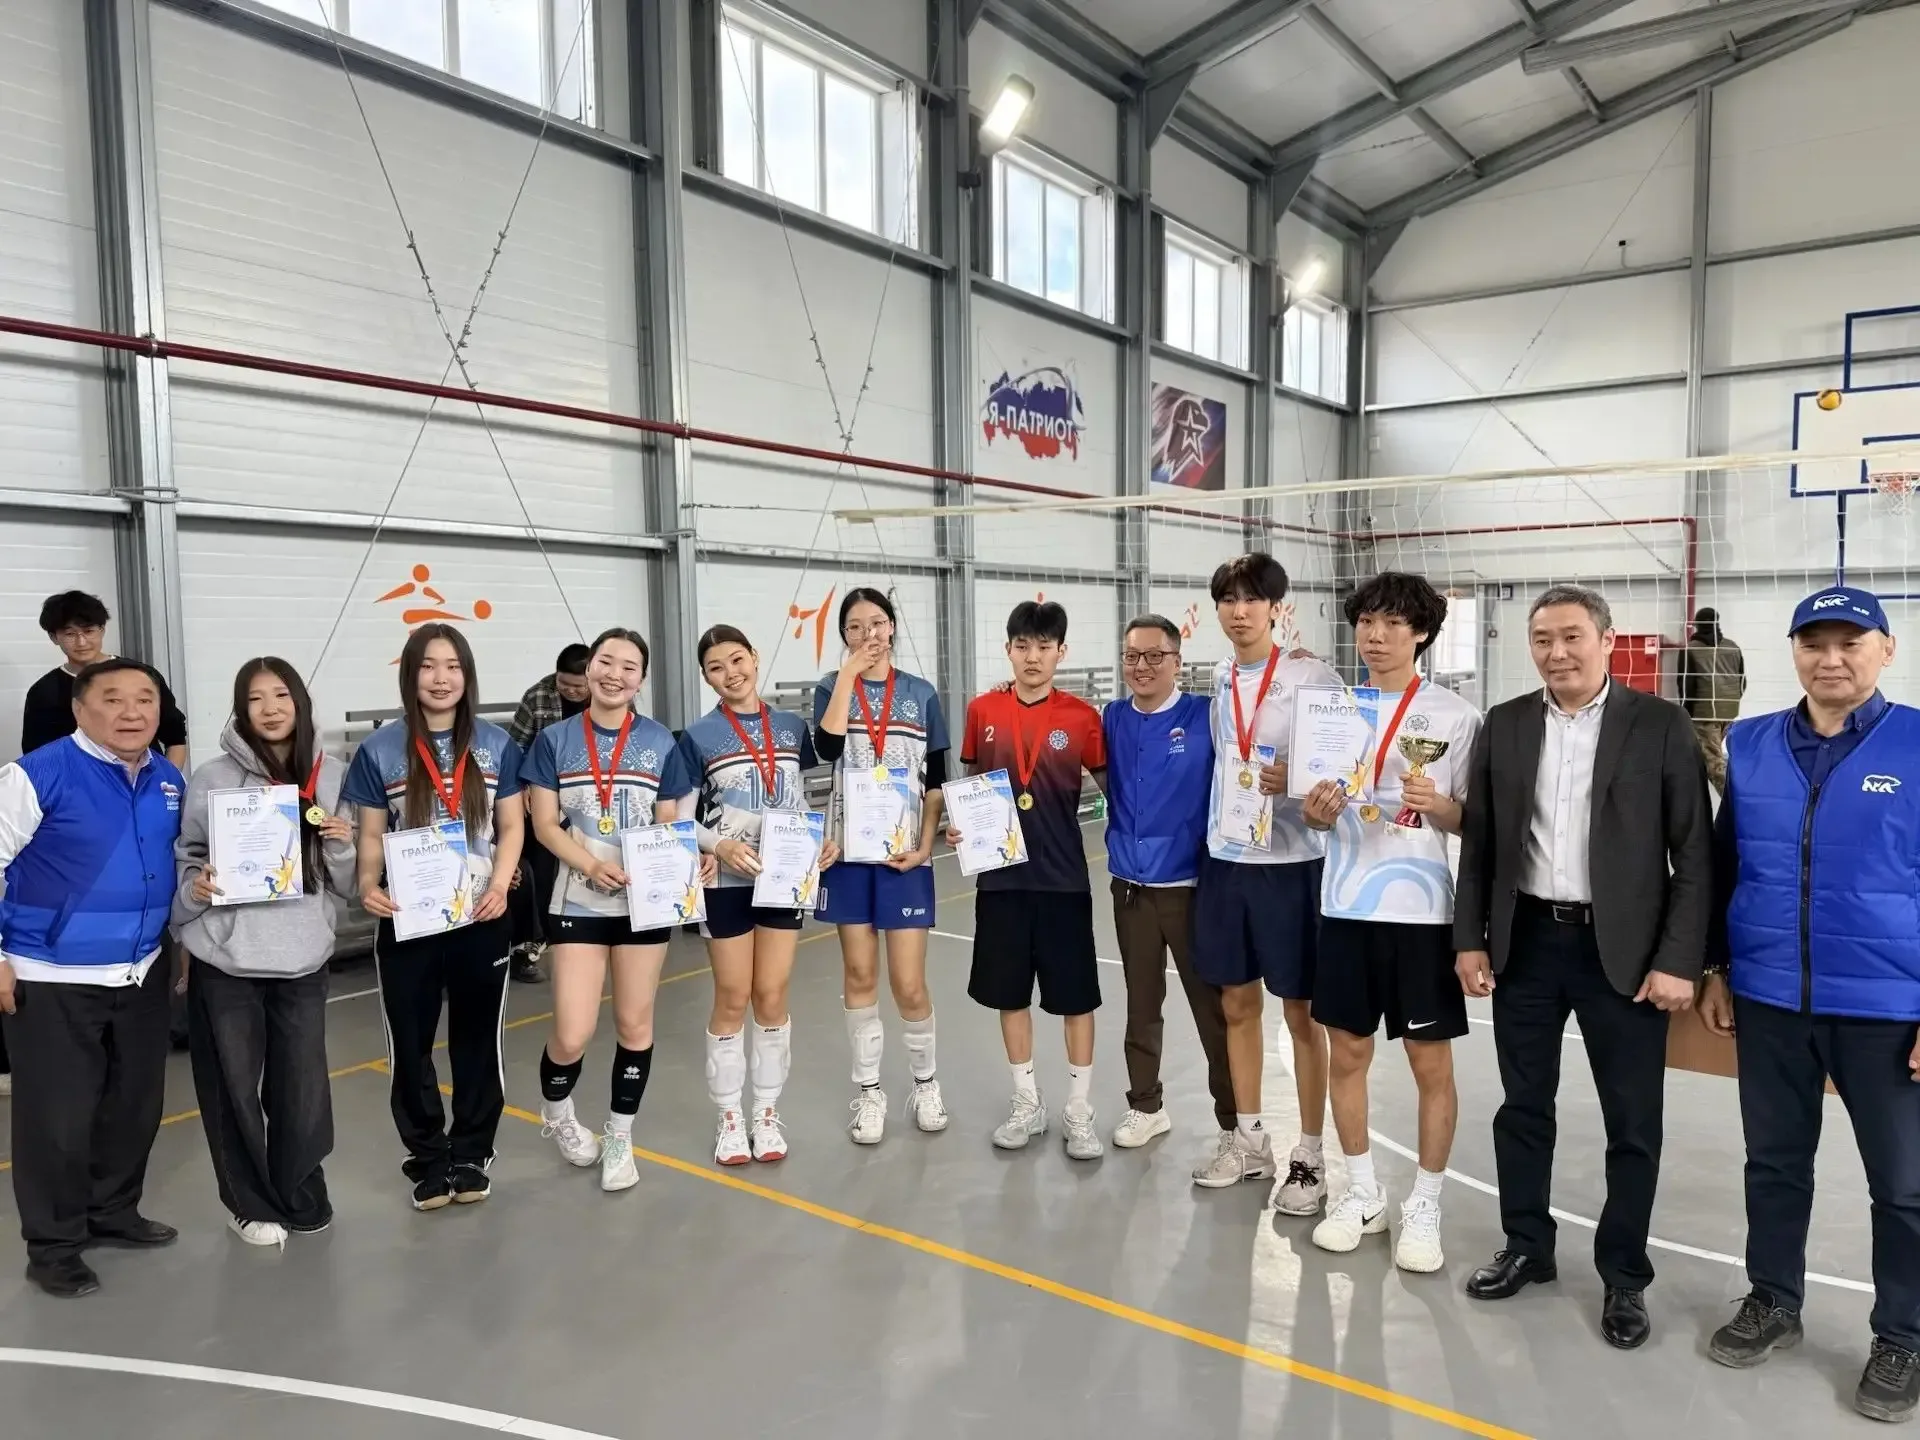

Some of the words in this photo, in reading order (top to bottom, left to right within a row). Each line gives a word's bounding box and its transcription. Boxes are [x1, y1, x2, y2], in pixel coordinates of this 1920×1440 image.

[989, 401, 1073, 442] Я-ПАТРИОТ
[1308, 704, 1360, 716] ГРАМОТА
[985, 726, 995, 742] 2
[1232, 757, 1261, 770] ГРОТА
[745, 765, 784, 809] 10
[856, 783, 895, 792] ГРОТА
[226, 806, 281, 818] ГРАМА
[401, 841, 450, 858] ГРАМОТА
[637, 839, 684, 853] ГРАМОТА
